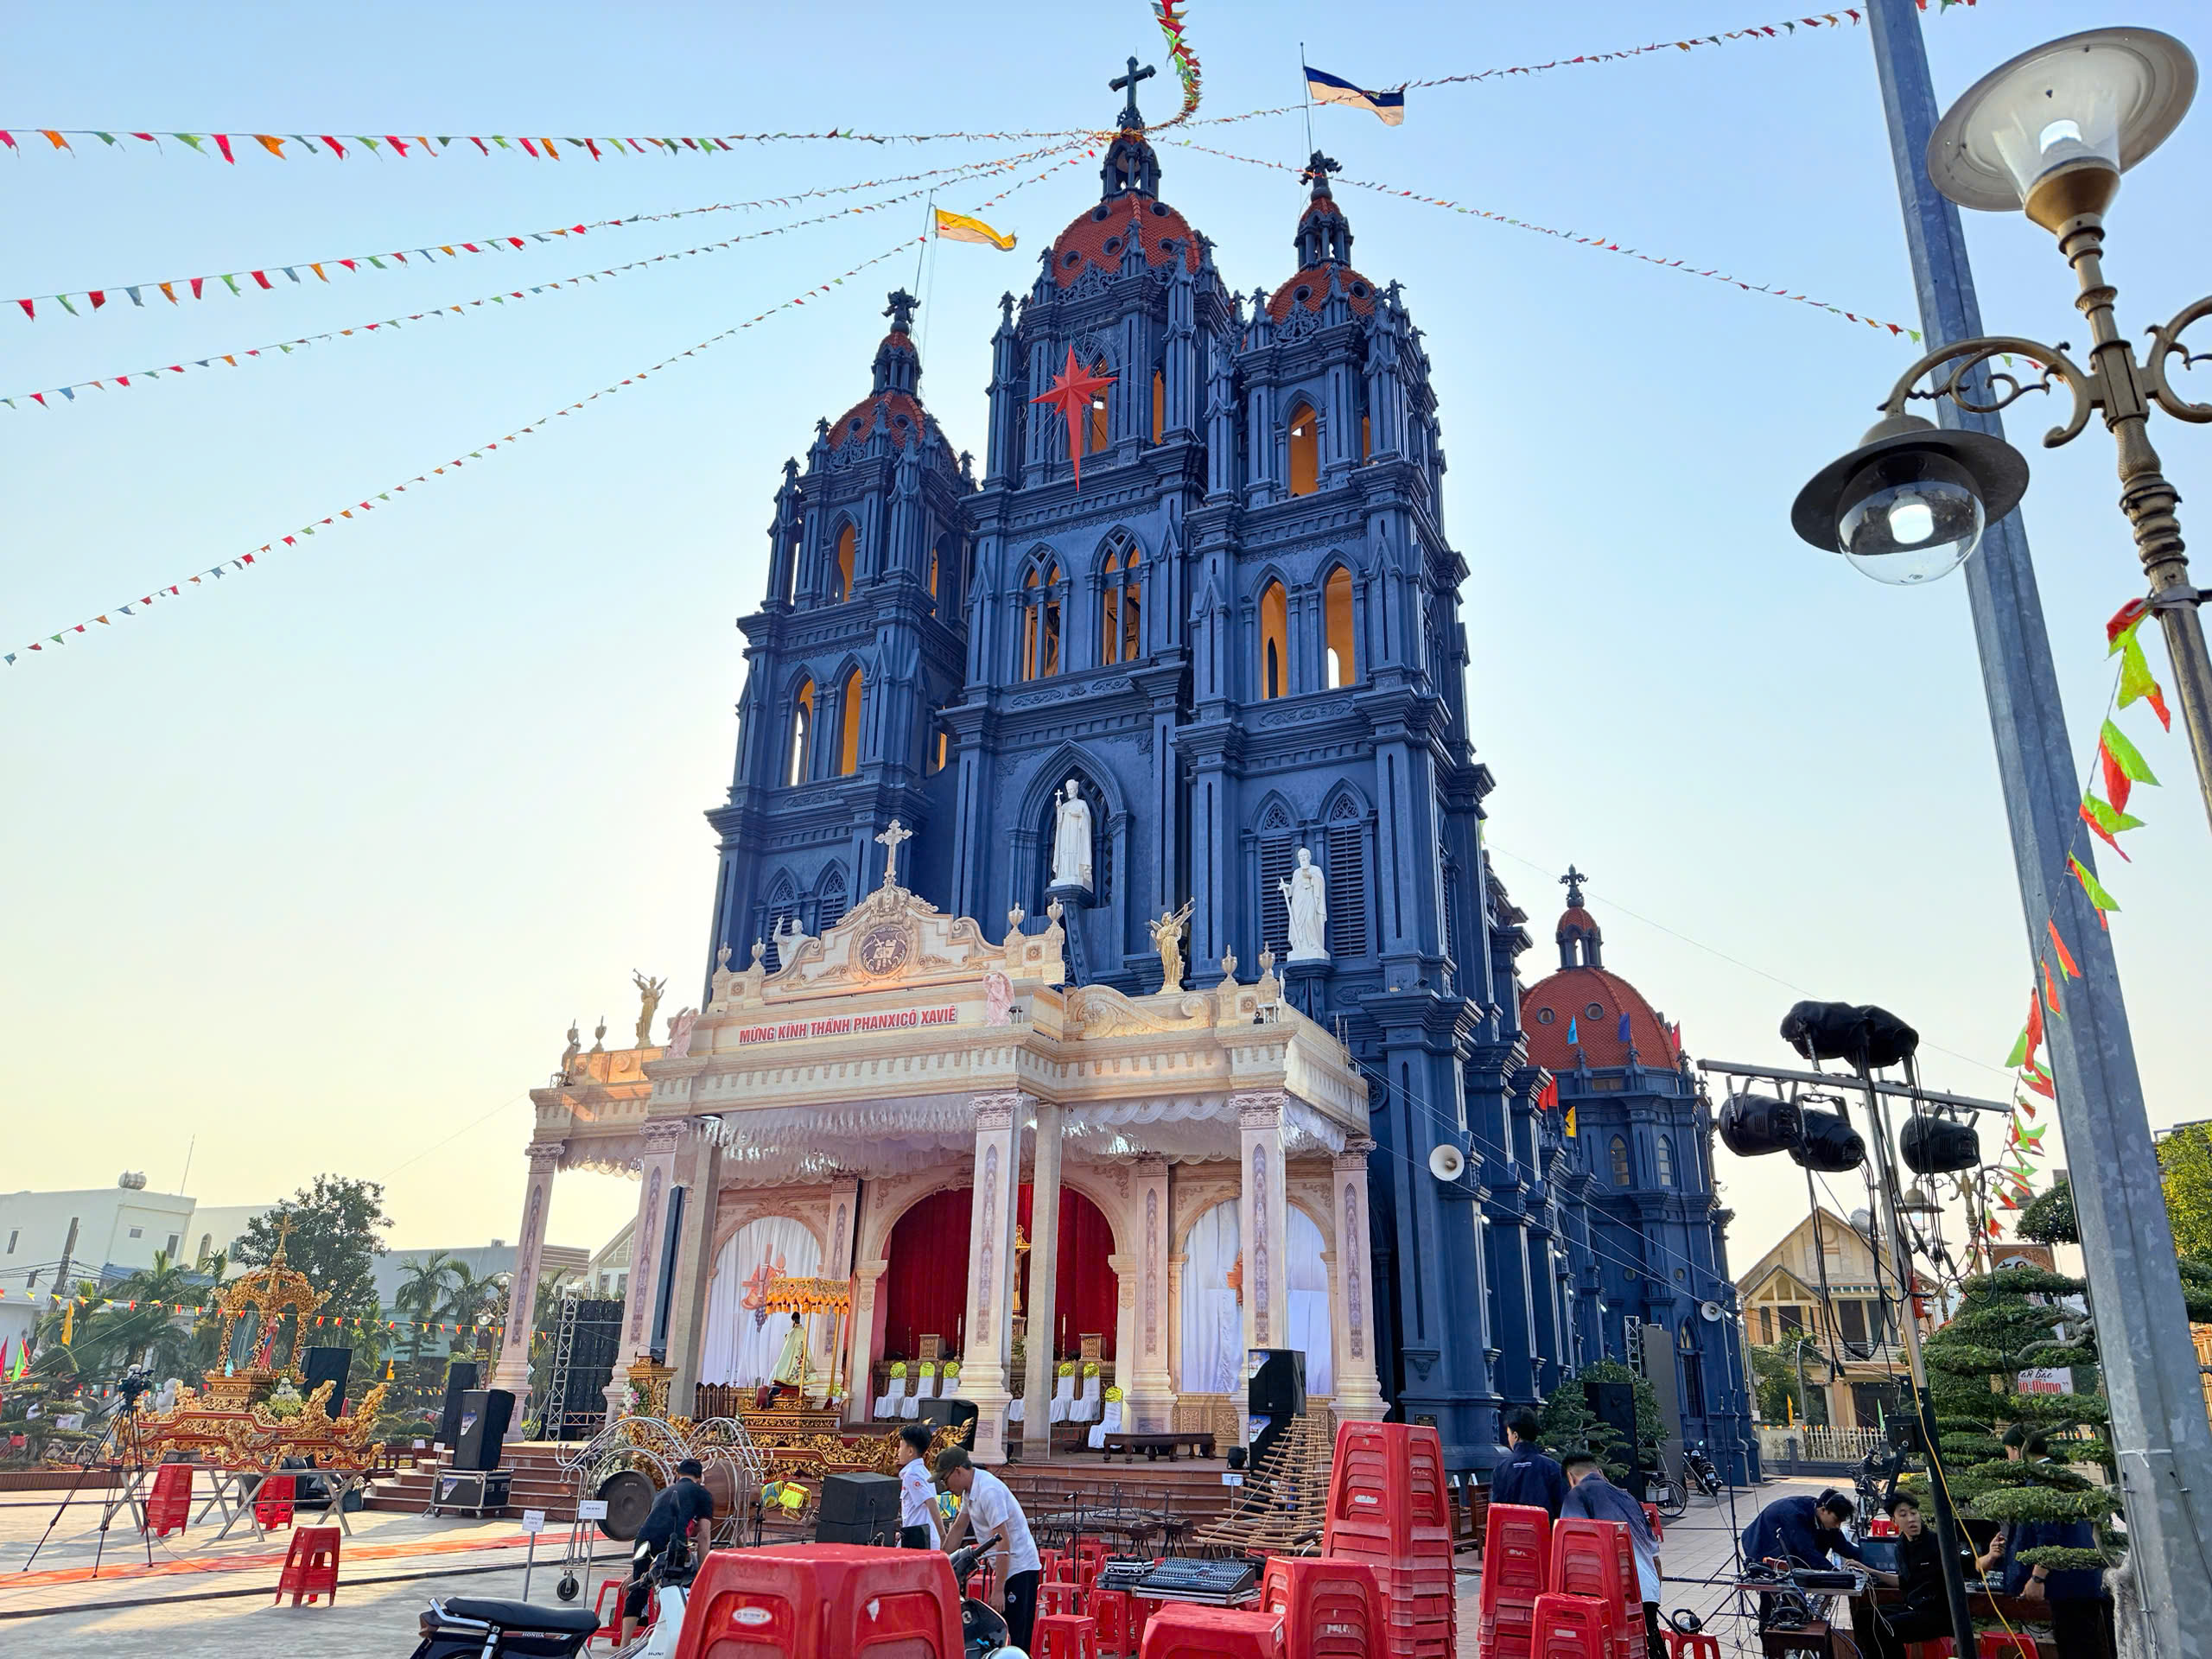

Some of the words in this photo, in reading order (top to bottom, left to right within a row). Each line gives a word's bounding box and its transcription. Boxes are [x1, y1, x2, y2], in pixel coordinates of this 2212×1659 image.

[739, 1026, 774, 1044] MỪNG
[778, 1022, 807, 1039] KÍNH
[810, 1018, 850, 1036] THÁNH
[853, 1008, 918, 1032] PHANXICÔ
[920, 1005, 956, 1025] XAVIÊ
